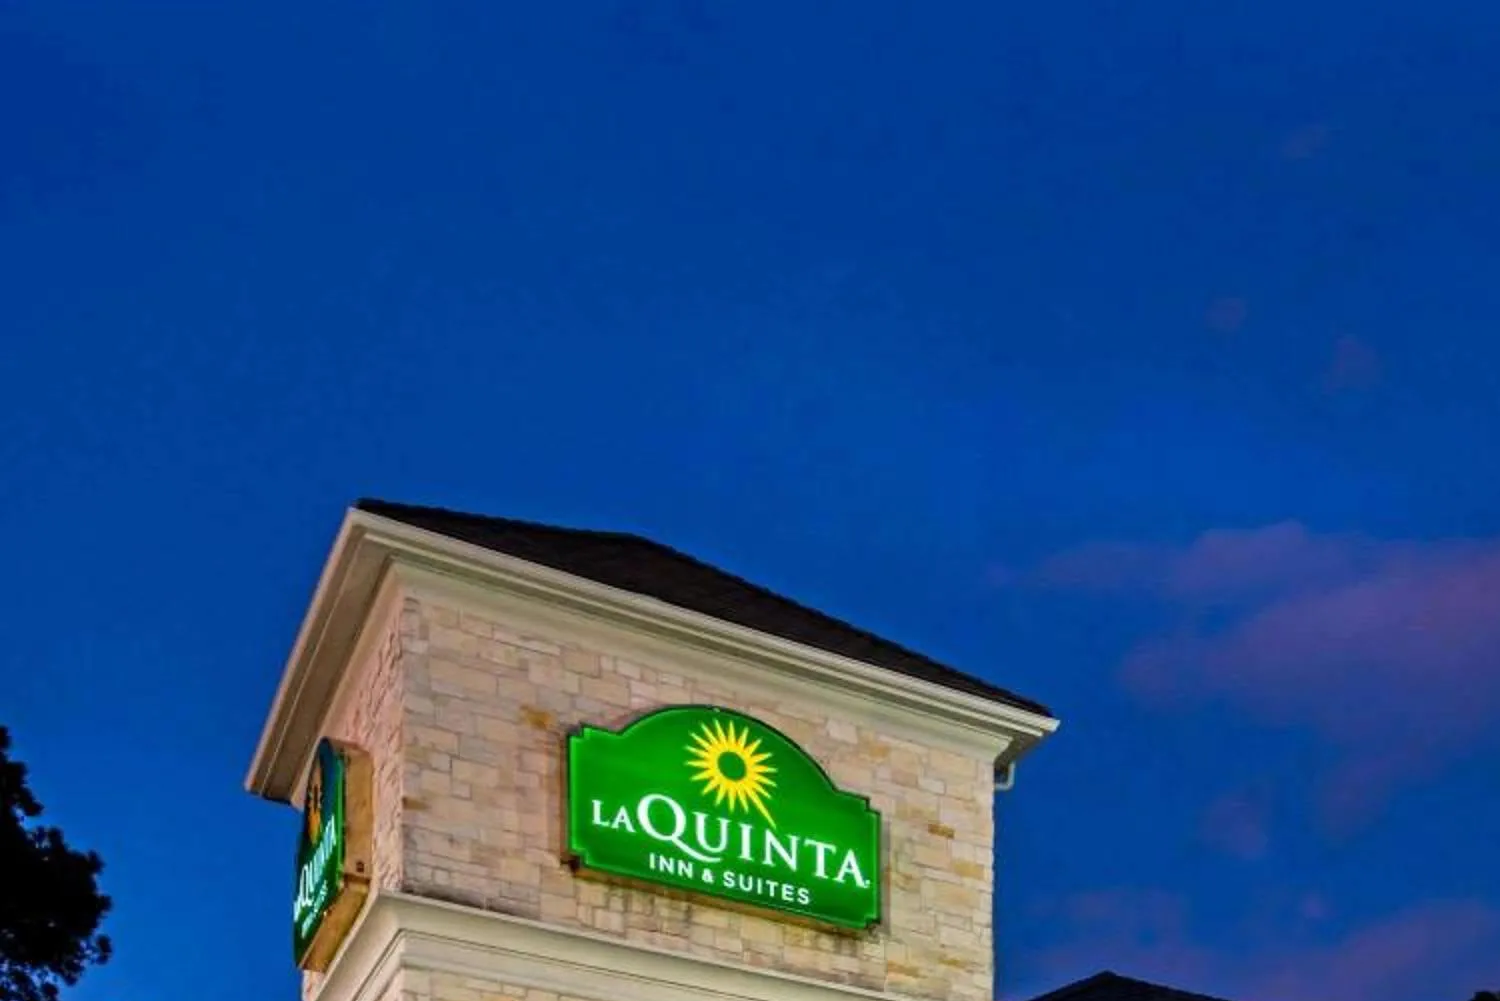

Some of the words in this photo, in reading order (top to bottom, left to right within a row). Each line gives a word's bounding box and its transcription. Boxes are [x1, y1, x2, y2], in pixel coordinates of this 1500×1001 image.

[591, 799, 636, 833] LA
[637, 793, 870, 889] QUINTA
[649, 852, 694, 879] INN
[701, 868, 715, 884] &
[723, 870, 811, 905] SUITES
